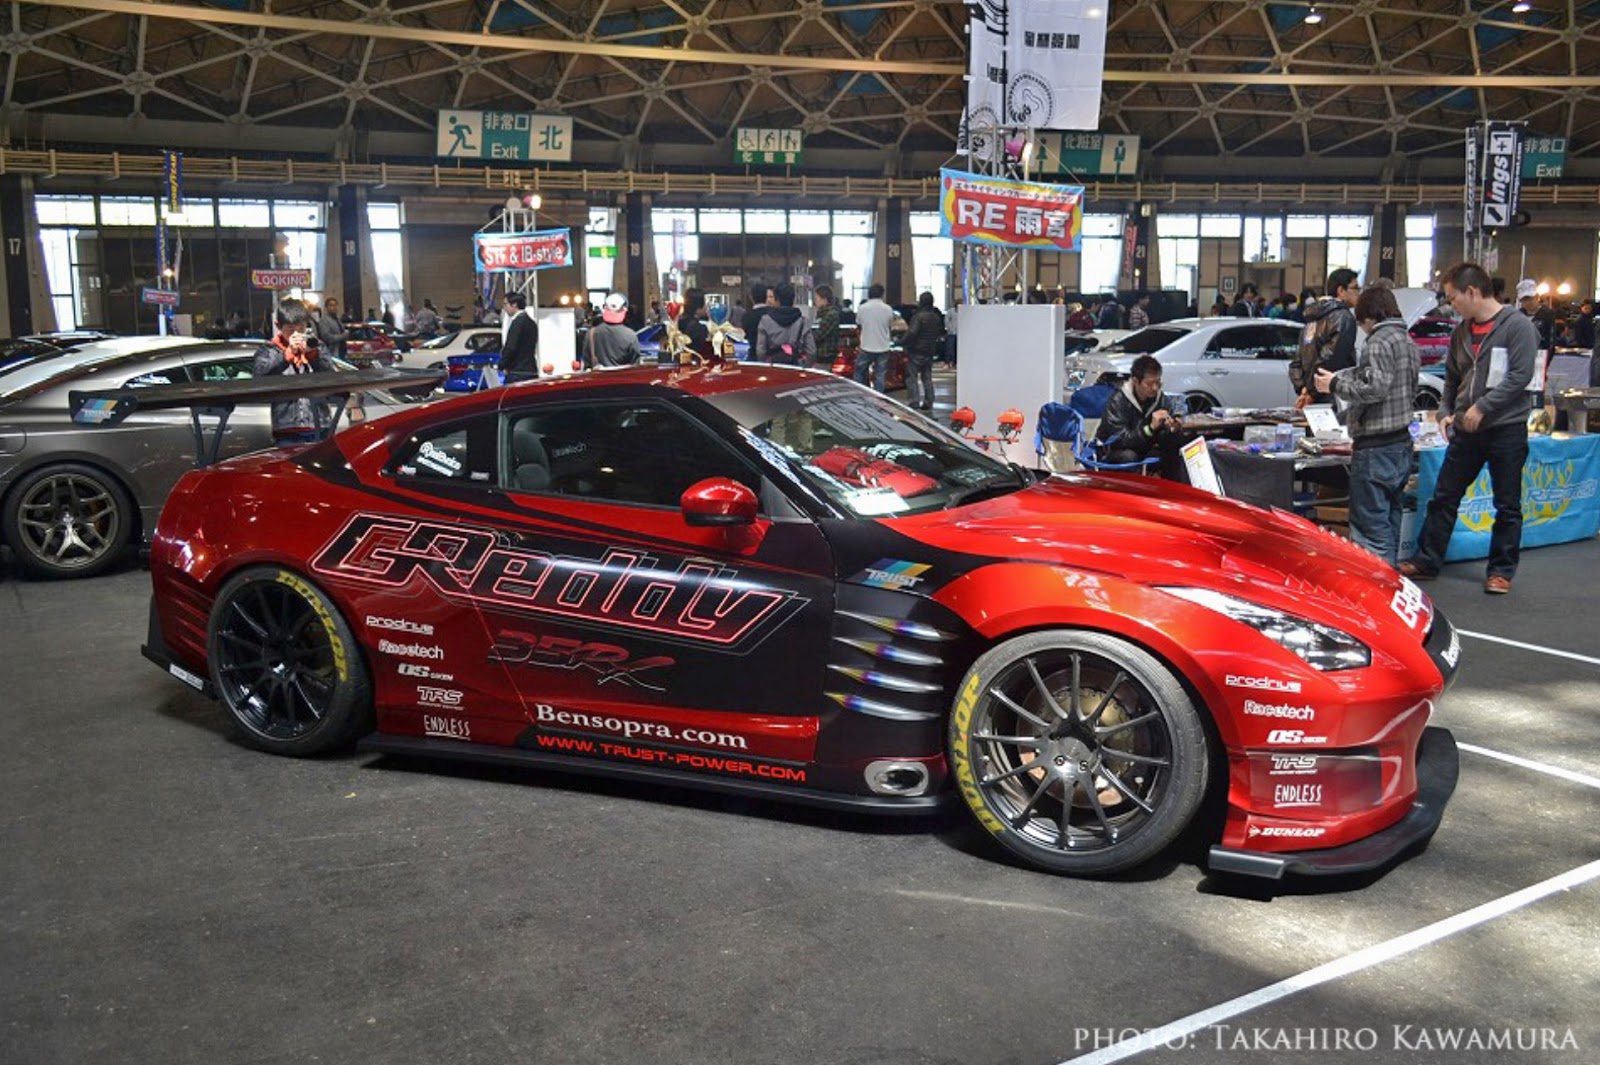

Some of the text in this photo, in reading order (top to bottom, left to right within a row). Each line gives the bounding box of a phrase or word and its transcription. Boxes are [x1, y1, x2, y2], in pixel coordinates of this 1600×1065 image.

[485, 112, 529, 131] 非常口
[538, 125, 563, 150] 北
[1525, 138, 1566, 153] 非常口
[491, 142, 520, 158] Exit
[1486, 155, 1510, 203] ings
[1536, 164, 1562, 177] Exit
[958, 198, 1070, 238] RE 雨宮
[8, 238, 21, 255] 17
[344, 239, 356, 256] 18
[510, 246, 518, 264] &
[888, 243, 900, 258] 20
[1135, 244, 1146, 258] 21
[1382, 246, 1393, 259] 22
[256, 275, 306, 286] LOOKING
[864, 568, 924, 588] TRUST
[417, 686, 464, 705] TRS
[424, 714, 471, 737] ENDLESS
[535, 703, 748, 749] Bensopra.com
[953, 673, 1005, 833] DUNLOP
[1274, 784, 1322, 803] ENDLESS
[1261, 826, 1326, 838] DUNLOP
